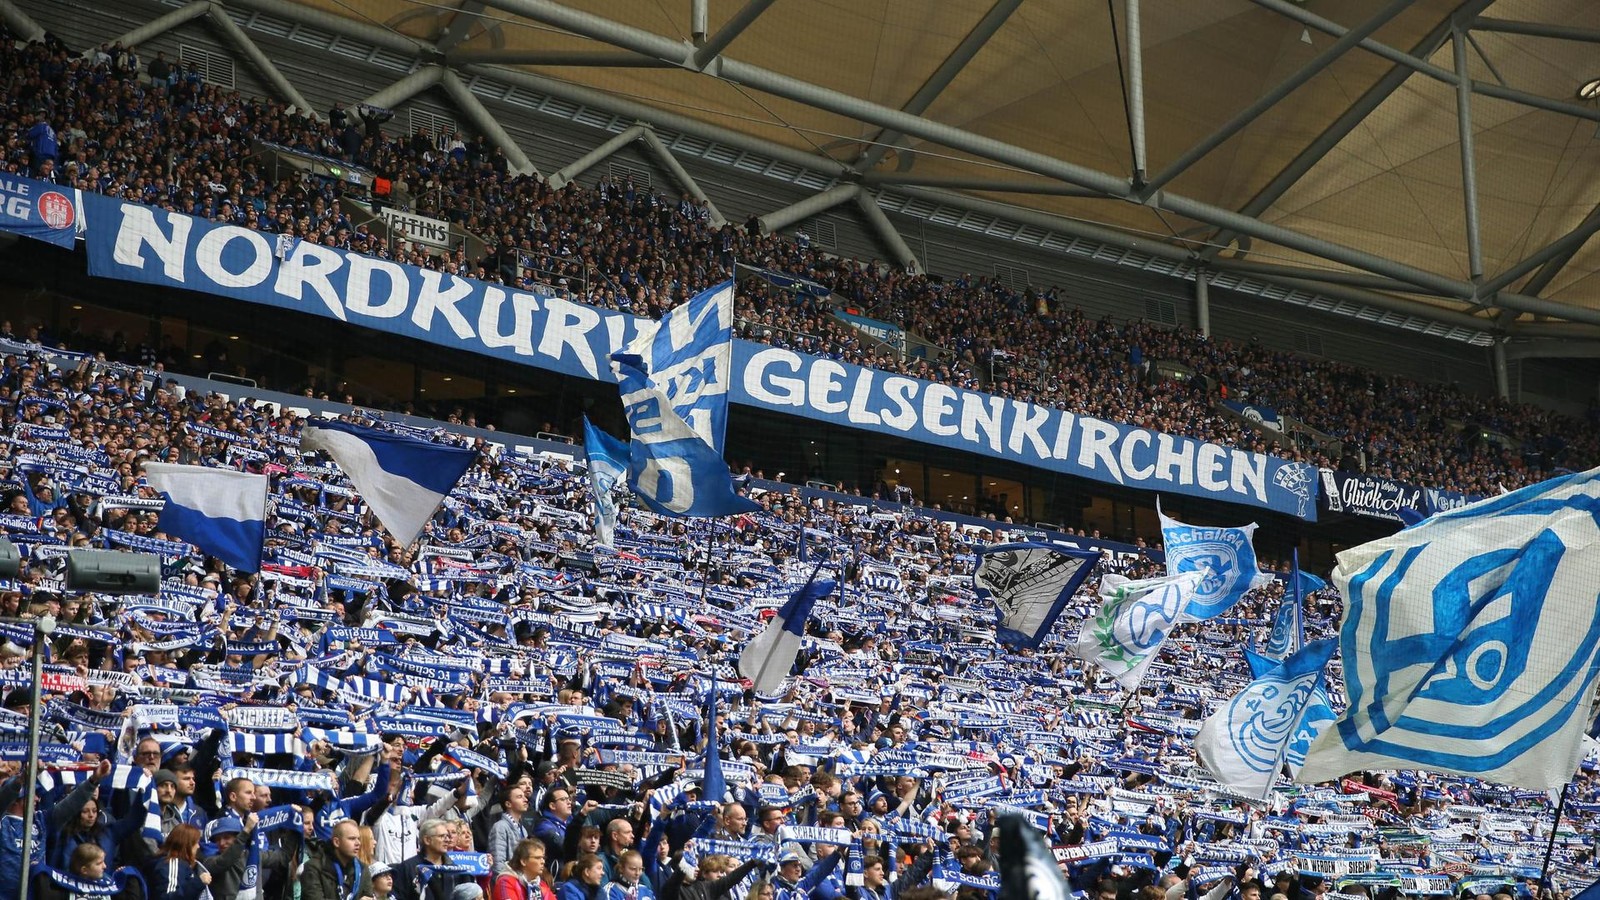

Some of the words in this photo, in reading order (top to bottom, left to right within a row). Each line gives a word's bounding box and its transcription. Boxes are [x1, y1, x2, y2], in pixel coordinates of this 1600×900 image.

[0, 194, 31, 220] G
[113, 203, 658, 380] NORDKURV
[194, 425, 209, 434] WIR
[211, 429, 235, 440] LEBEN
[744, 348, 1267, 503] GELSENKIRCHEN
[29, 428, 37, 436] FC
[38, 428, 63, 438] Schalke
[1342, 477, 1383, 509] Glück
[27, 522, 37, 532] 04
[112, 532, 186, 552] SCHALKE
[323, 535, 333, 544] FC
[334, 535, 362, 546] Schalke
[362, 536, 372, 546] 04
[284, 547, 317, 564] Schalke
[275, 592, 307, 607] Schalke
[453, 607, 502, 620] SCHALKE
[517, 609, 527, 620] FC
[7, 630, 33, 642] REVIER
[332, 627, 379, 641] Mitglied
[258, 641, 274, 651] 04
[388, 657, 436, 679] Schalke
[437, 670, 450, 680] FC
[502, 685, 527, 693] LEBEN
[190, 710, 220, 723] Schalke
[562, 717, 576, 725] bin
[578, 719, 591, 727] ein
[592, 719, 623, 730] Schalk
[380, 720, 434, 734] Schalke
[609, 736, 626, 744] FANS
[614, 751, 624, 761] FC
[626, 752, 655, 763] SCHALKE
[657, 753, 666, 763] 04
[257, 811, 289, 830] chalke
[792, 826, 827, 841] SCHALKE
[829, 829, 839, 841] 04
[1120, 835, 1158, 850] Schalke
[1310, 859, 1336, 873] WERDEN
[942, 869, 958, 880] FC
[959, 870, 1000, 888] Schalk
